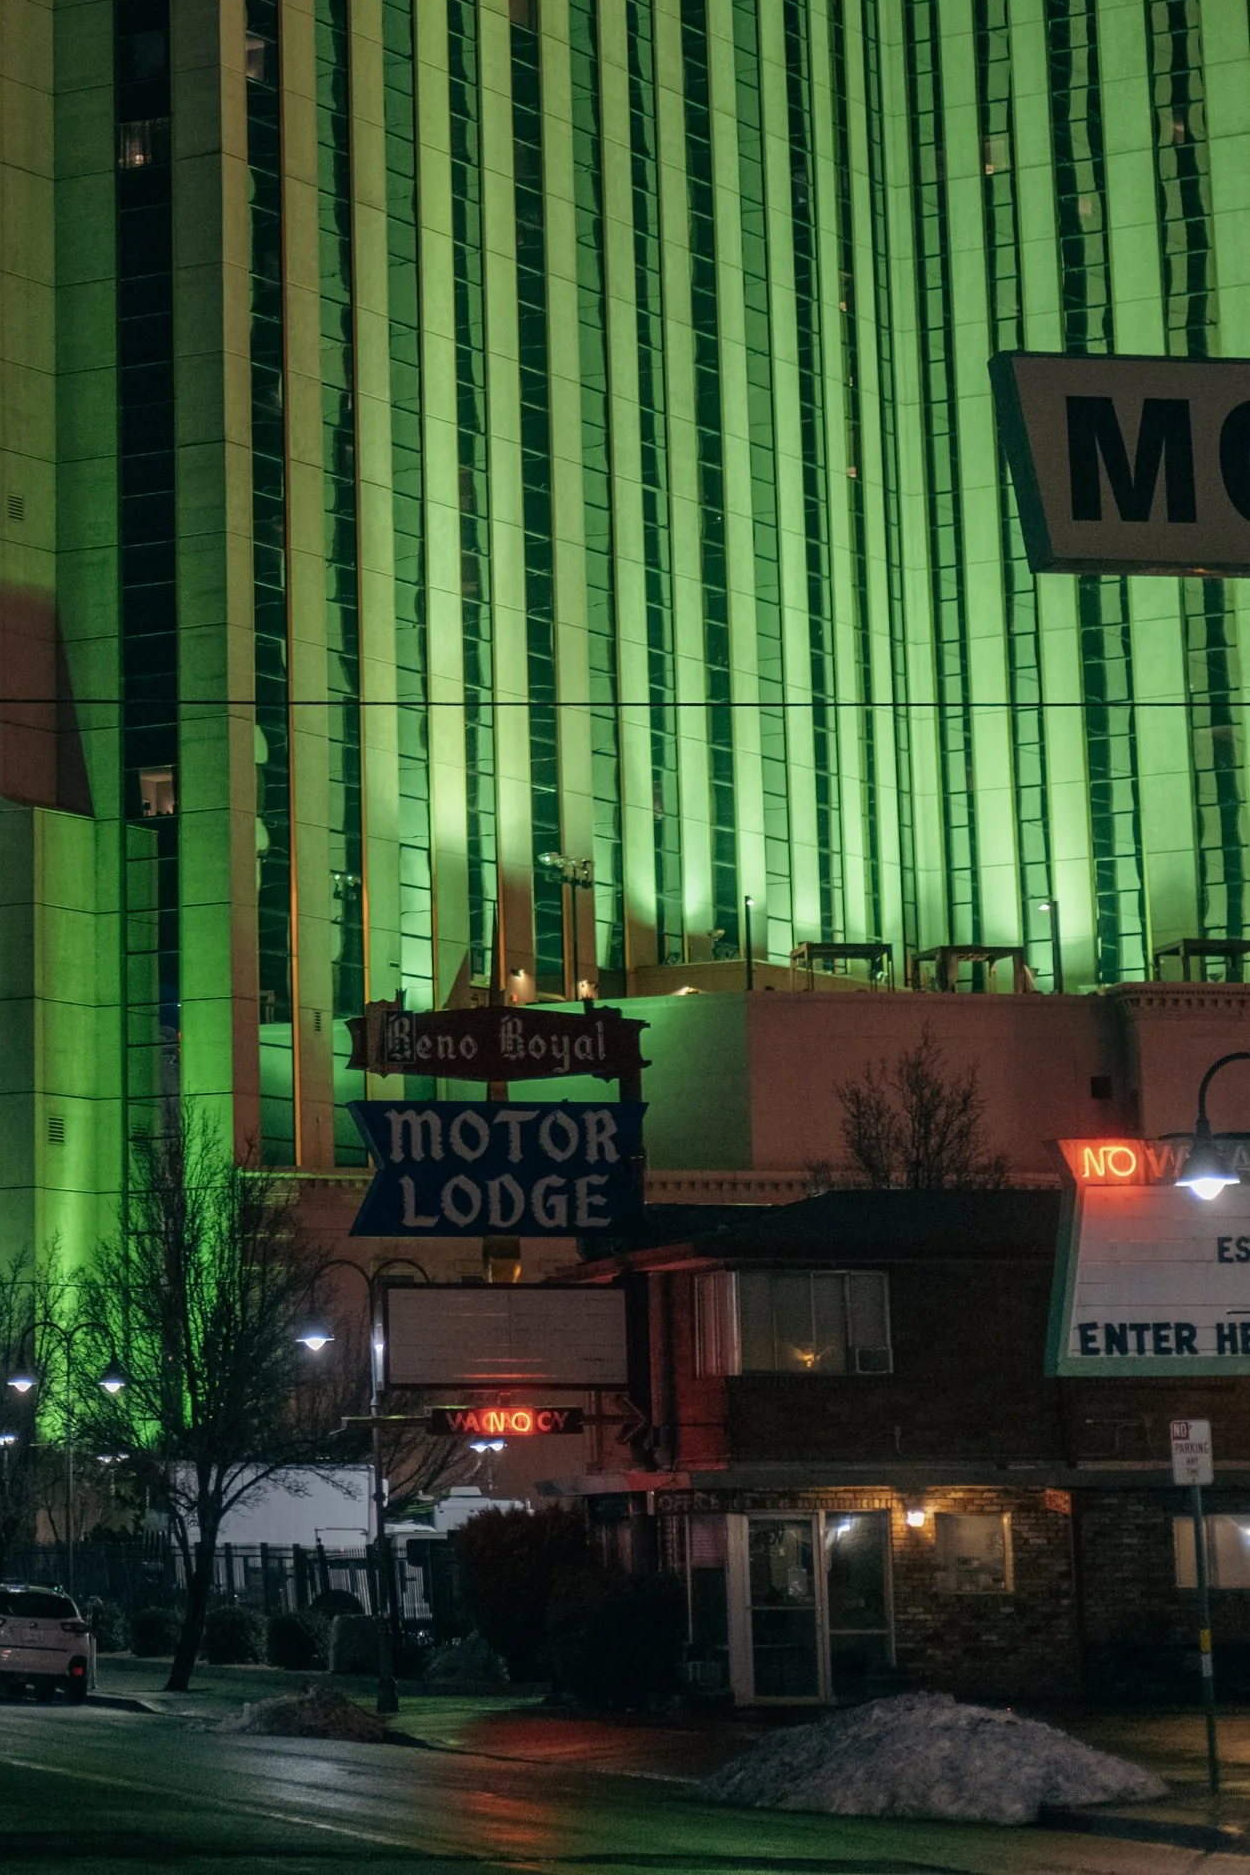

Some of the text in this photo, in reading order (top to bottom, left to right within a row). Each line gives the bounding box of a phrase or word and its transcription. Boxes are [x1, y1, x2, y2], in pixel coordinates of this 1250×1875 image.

[1066, 396, 1250, 523] M
[387, 1013, 608, 1073] Reno Royal
[386, 1108, 621, 1163] MOTOR
[1082, 1146, 1137, 1178] NO
[398, 1172, 611, 1228] LODGE
[1078, 1321, 1199, 1356] ENTER
[1173, 1423, 1187, 1438] NO
[1174, 1442, 1209, 1454] PARKING
[1186, 1456, 1199, 1465] ANY
